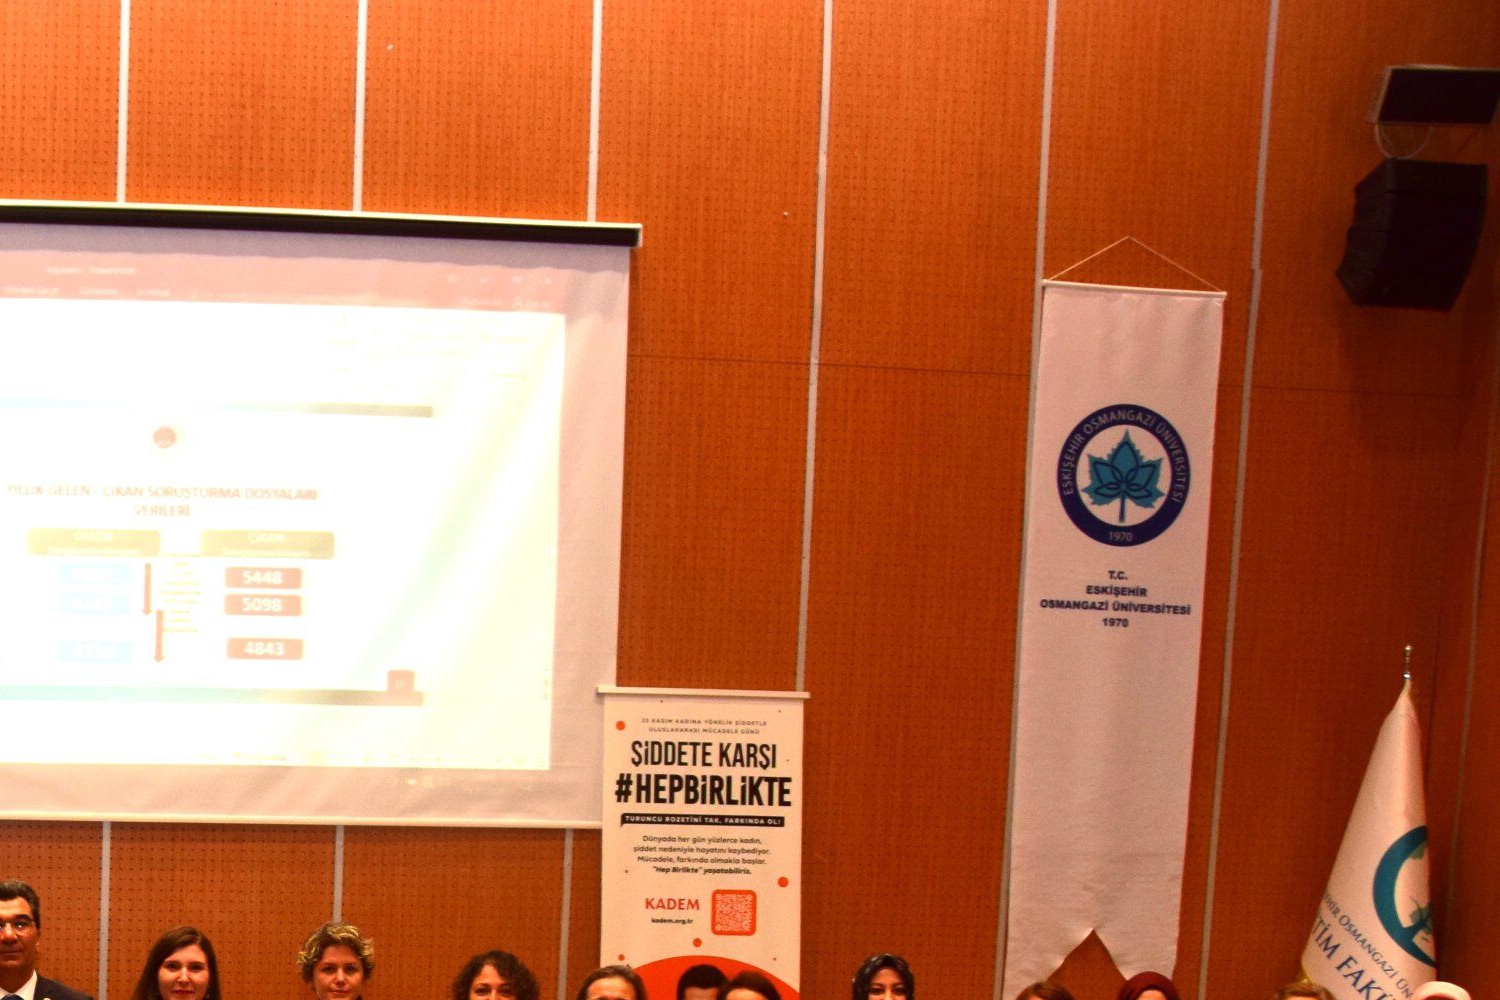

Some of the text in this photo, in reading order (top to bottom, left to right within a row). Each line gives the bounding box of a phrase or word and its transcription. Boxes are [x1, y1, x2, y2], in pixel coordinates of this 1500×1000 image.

[1083, 409, 1156, 439] OSMANGAZİ
[1107, 530, 1133, 542] 1970
[242, 569, 283, 585] 5448
[1108, 570, 1128, 580] T.C.
[1085, 583, 1148, 598] ESKİŞEHİR
[242, 597, 282, 612] 5098
[1039, 598, 1192, 615] OSMANGAZİ ÜNİVERSİTESİ
[1102, 617, 1130, 628] 1970
[244, 640, 285, 656] 4843
[719, 742, 777, 770] KARŞI
[625, 815, 663, 823] TURUNCU
[665, 815, 702, 823] ROZETİNİ
[642, 835, 677, 844] Dünyada
[692, 836, 706, 844] gün
[708, 836, 738, 845] yüzlerce
[633, 845, 657, 854] şiddet
[659, 846, 694, 855] nedeniyle
[696, 846, 726, 855] hayatını
[676, 856, 709, 864] farkında
[645, 897, 700, 911] KADEM
[651, 917, 694, 926] kadem.org.tr
